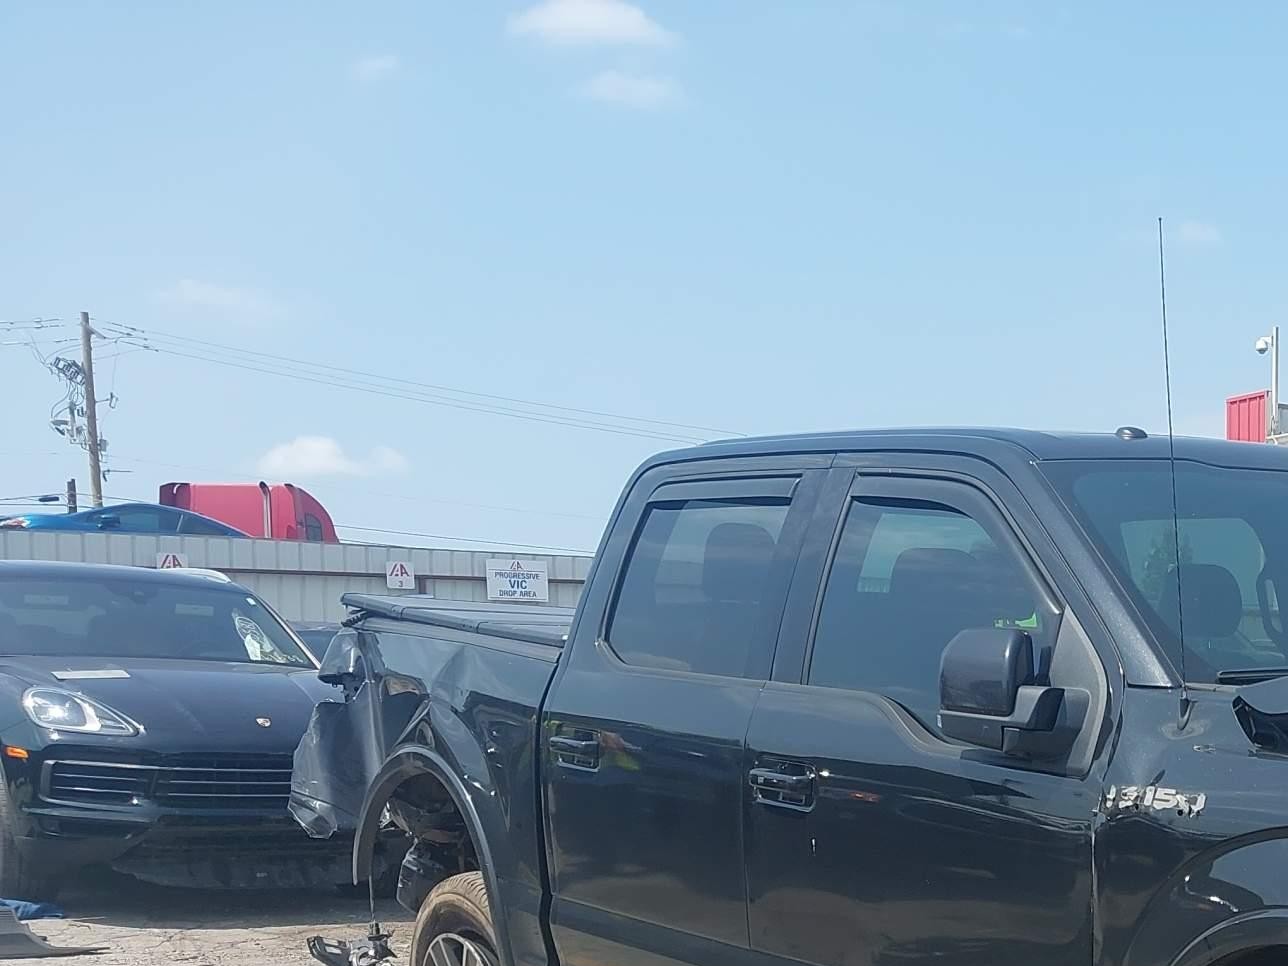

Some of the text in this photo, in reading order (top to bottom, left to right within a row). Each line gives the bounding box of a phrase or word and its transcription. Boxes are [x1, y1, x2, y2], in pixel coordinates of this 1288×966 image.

[494, 571, 541, 580] PROGRESSIVE
[508, 579, 528, 590] VIC
[498, 589, 537, 598] DROP AREA
